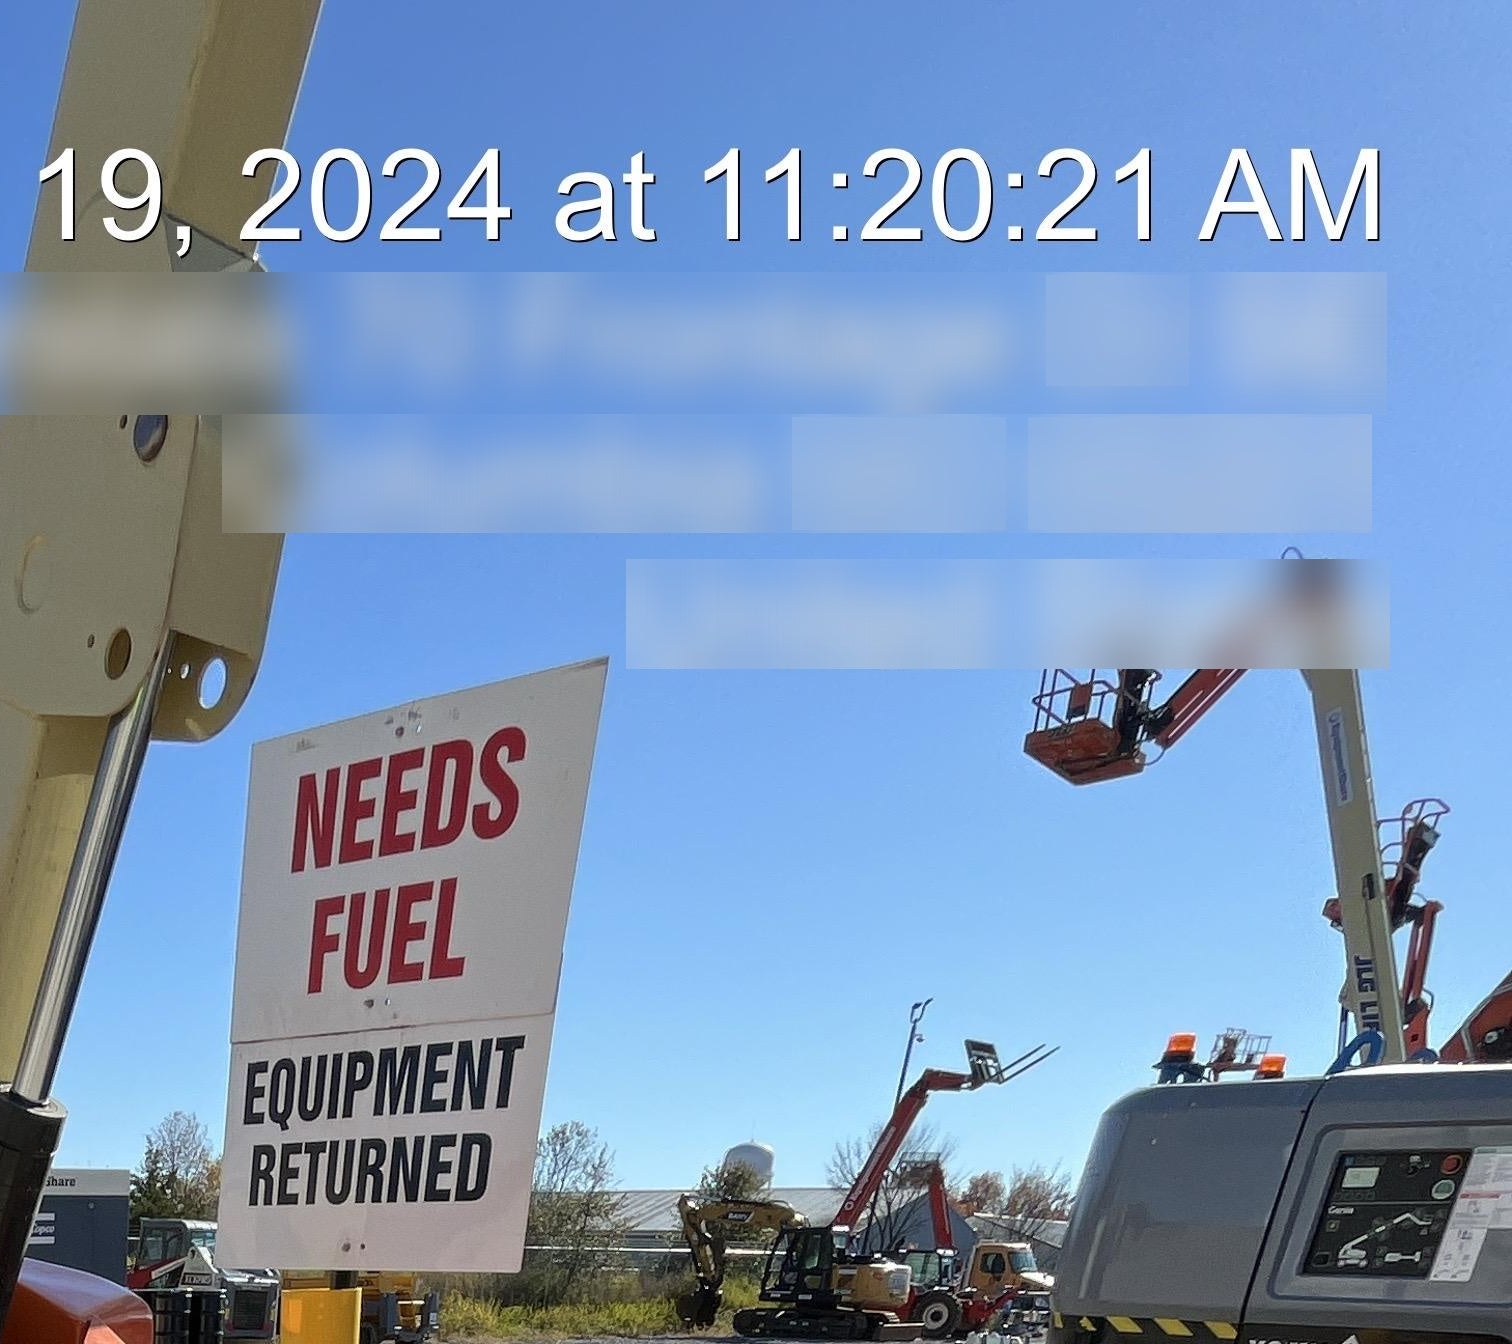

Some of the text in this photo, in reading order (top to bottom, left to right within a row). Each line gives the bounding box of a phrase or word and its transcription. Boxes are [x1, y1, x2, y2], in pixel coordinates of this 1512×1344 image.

[291, 726, 527, 874] NEEDS
[307, 877, 466, 995] FUEL
[1354, 955, 1380, 1031] JLG LIF
[243, 1035, 526, 1131] EQUIPMENT
[249, 1132, 493, 1207] RETURNED
